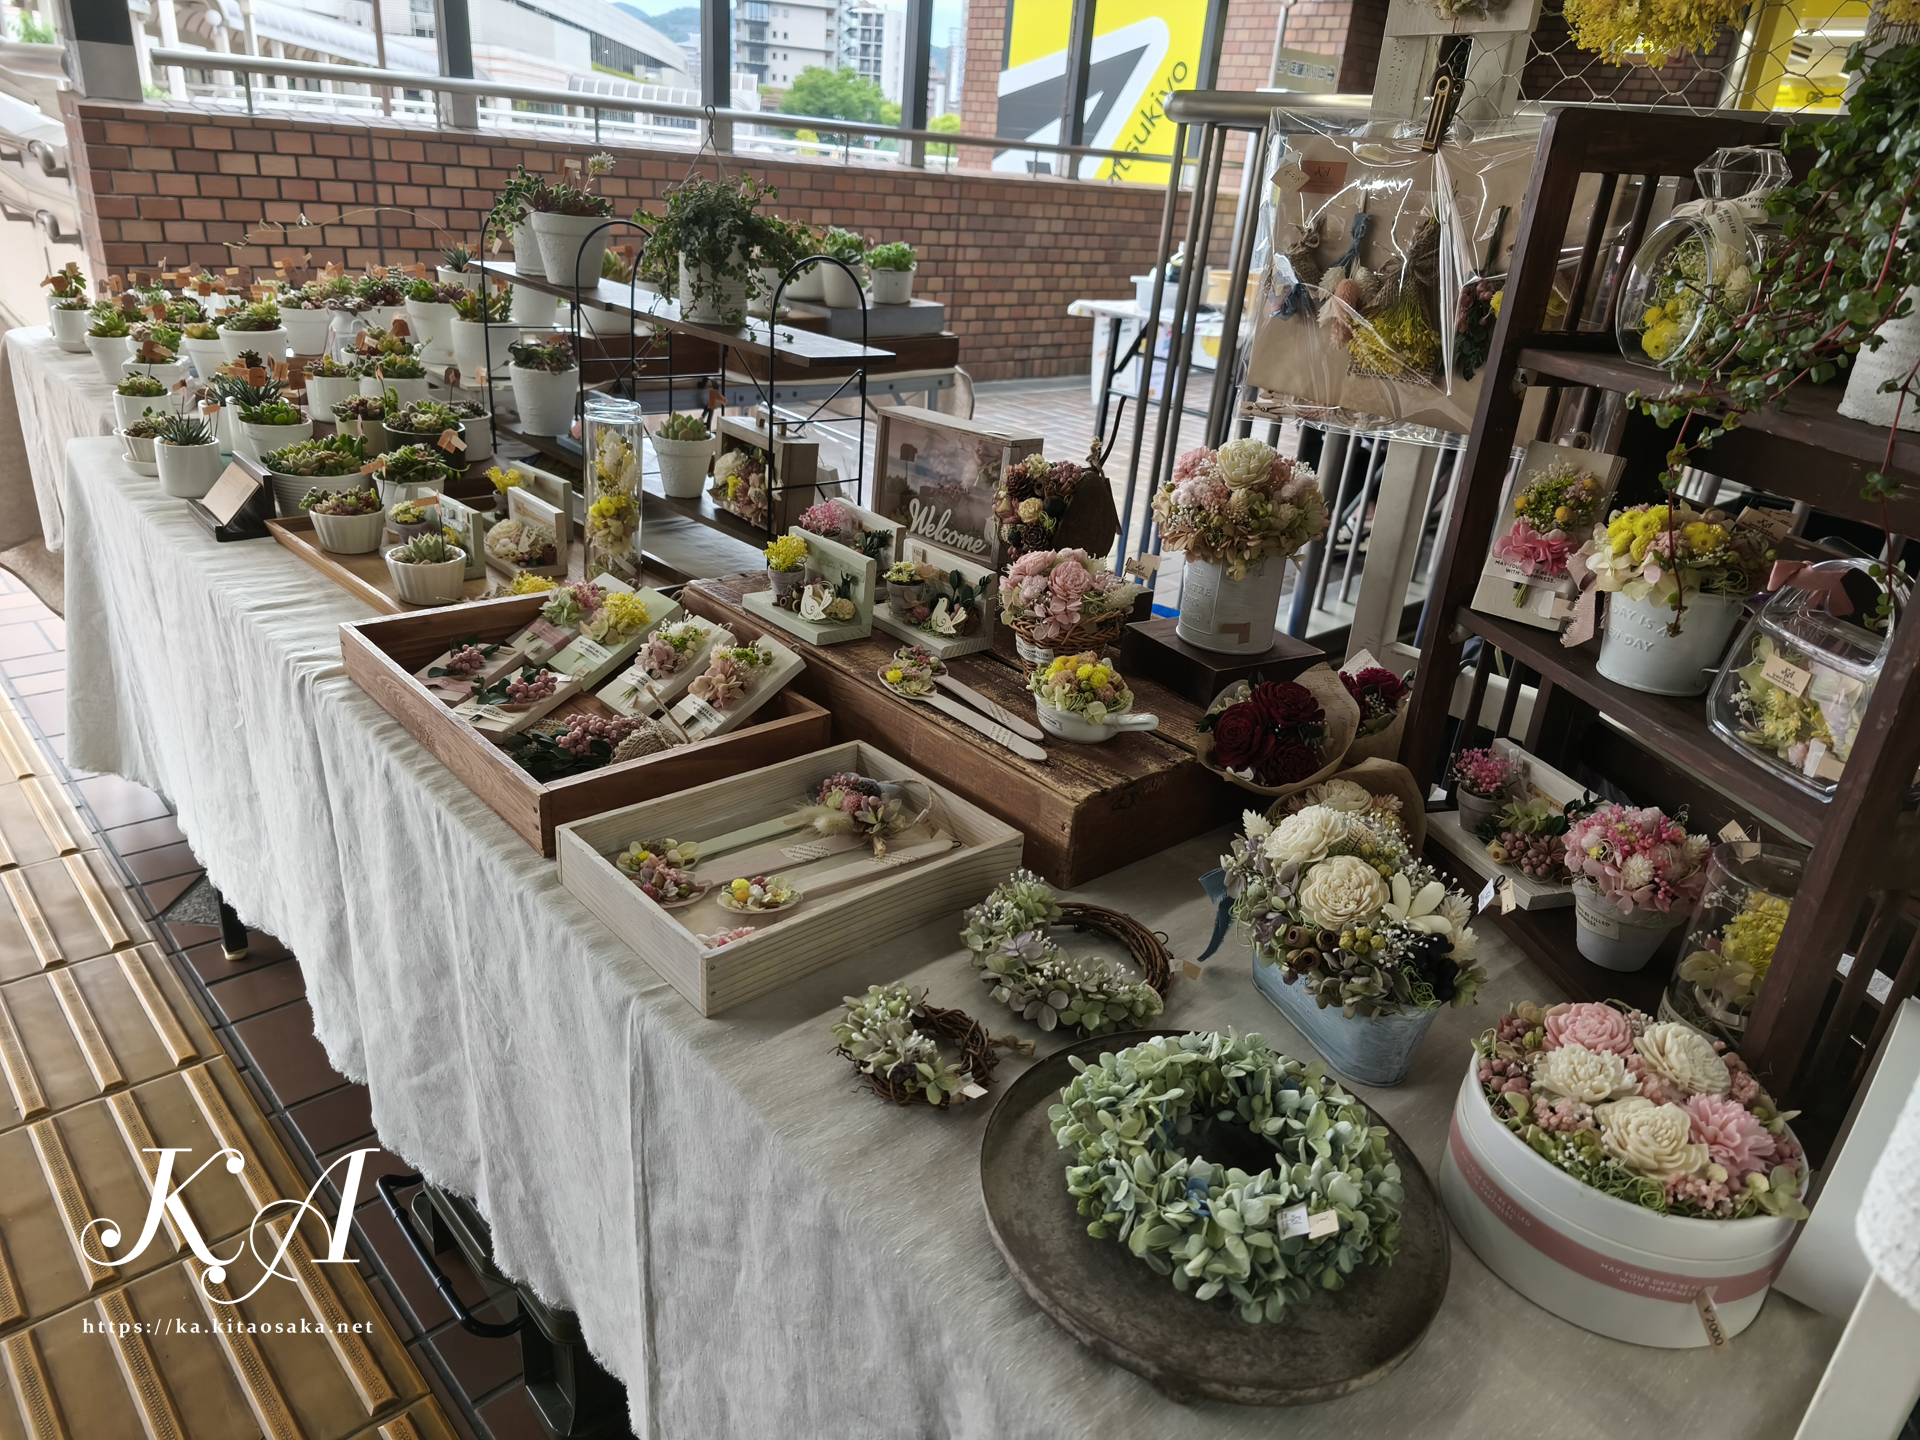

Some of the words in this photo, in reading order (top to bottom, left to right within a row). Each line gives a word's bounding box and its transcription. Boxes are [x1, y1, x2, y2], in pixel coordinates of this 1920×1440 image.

[909, 498, 986, 553] Welcome
[1505, 568, 1520, 576] WITH
[1612, 603, 1637, 620] DAY
[1639, 614, 1655, 630] IS
[1624, 633, 1655, 652] DAY
[1600, 1262, 1622, 1274] MAY
[1624, 1271, 1650, 1283] YOUR
[1619, 1276, 1645, 1288] WITH
